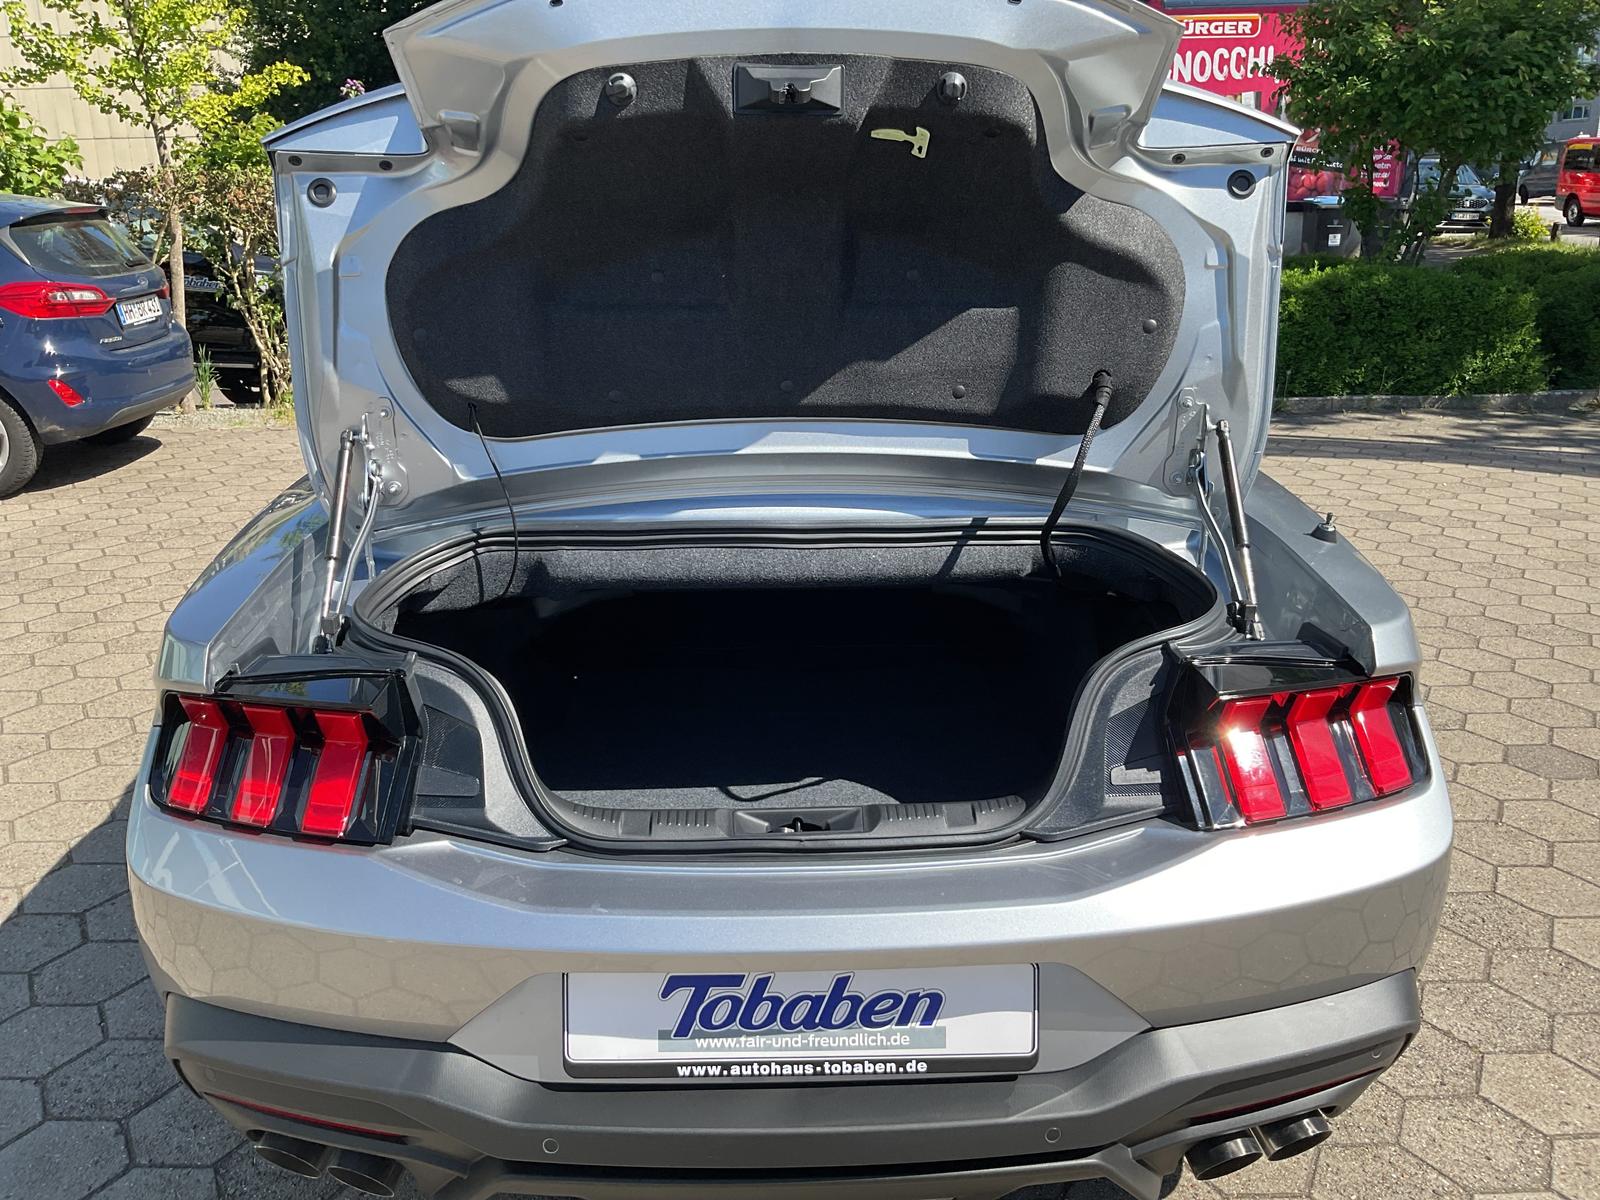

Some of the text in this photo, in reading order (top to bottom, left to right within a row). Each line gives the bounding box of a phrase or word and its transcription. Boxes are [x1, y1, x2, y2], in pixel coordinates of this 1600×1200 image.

[1183, 19, 1252, 35] ÜRGER
[1172, 45, 1275, 83] NOCCHI
[659, 971, 945, 1039] Tobaben
[695, 1032, 911, 1049] www.fair-und-freundlich.de
[677, 1059, 928, 1076] www.autohaus-tobaben.de
